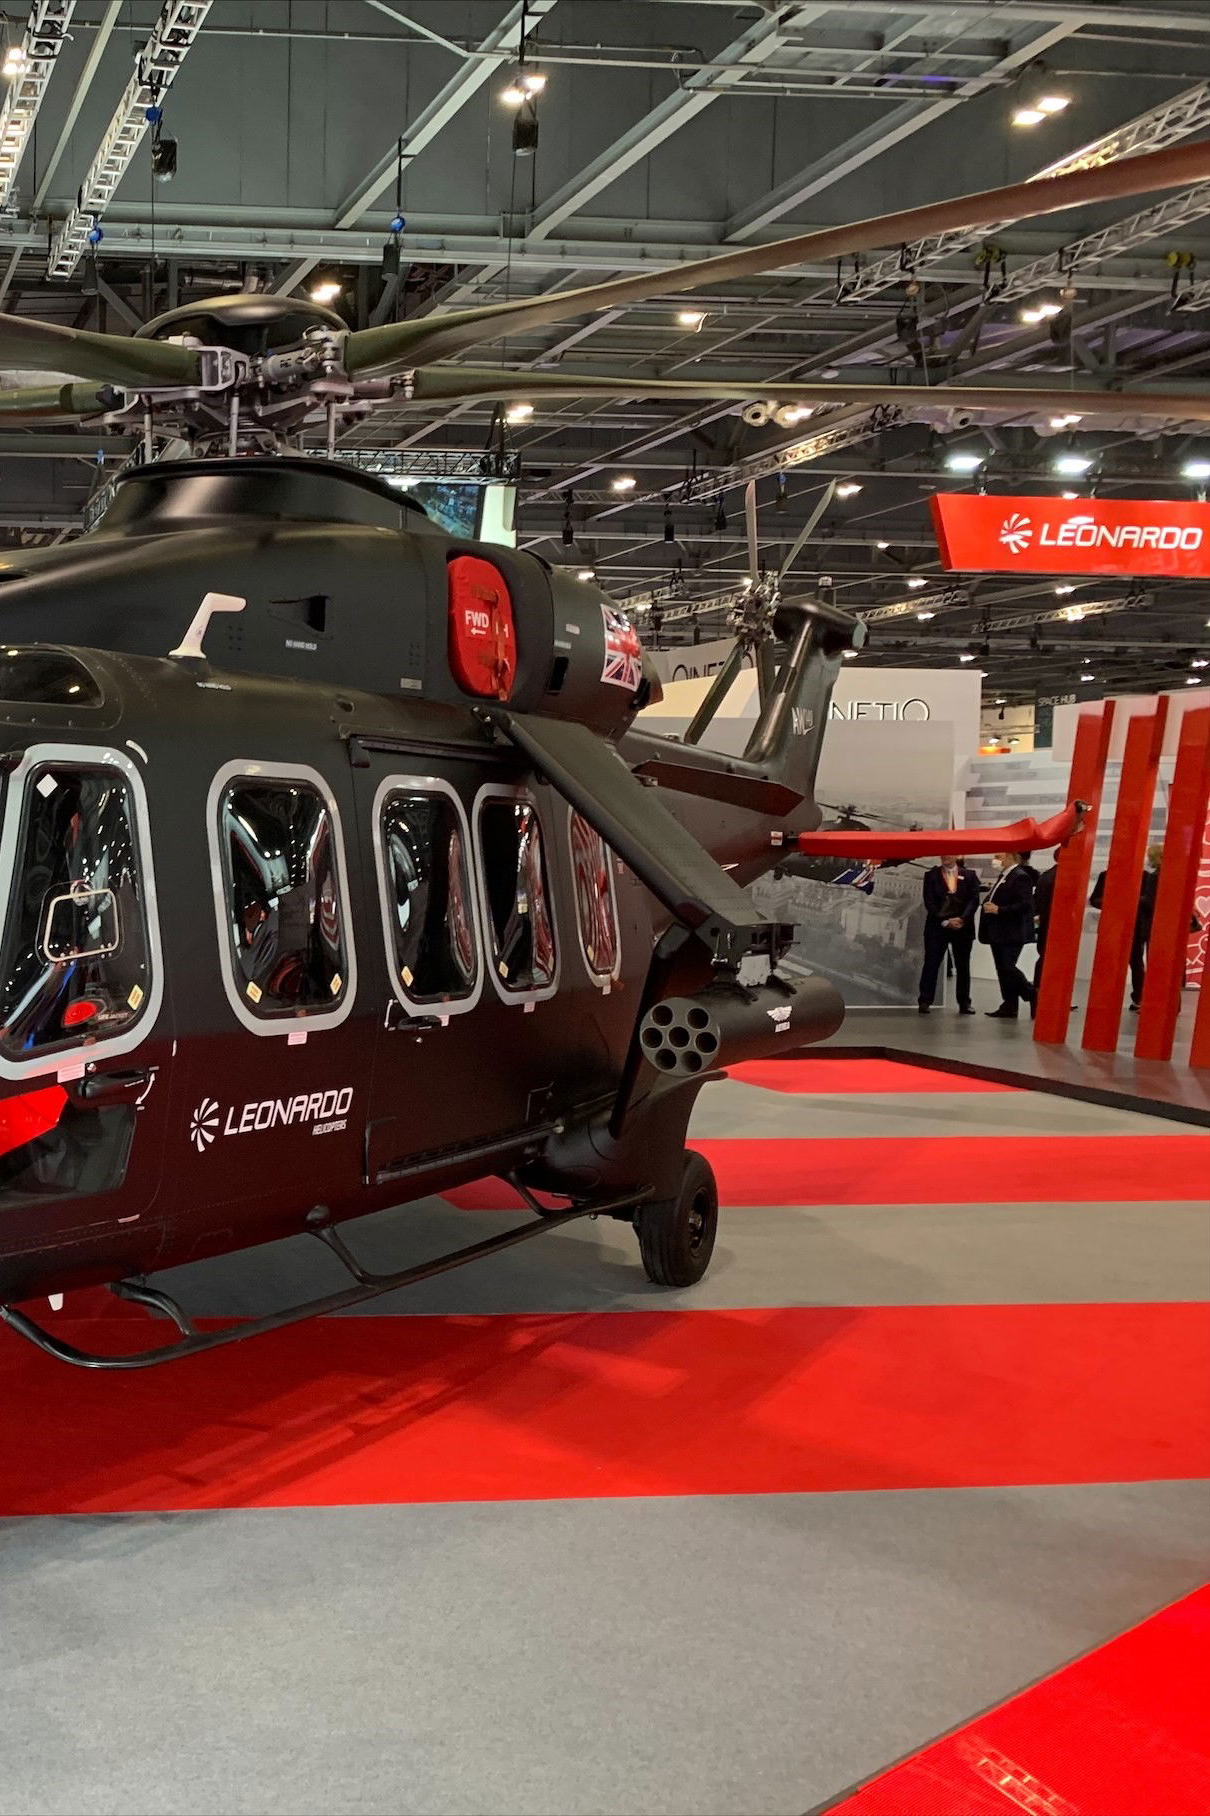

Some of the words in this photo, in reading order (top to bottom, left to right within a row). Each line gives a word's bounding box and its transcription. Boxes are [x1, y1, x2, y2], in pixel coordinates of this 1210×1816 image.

[1040, 523, 1203, 550] LEONARDO
[465, 610, 490, 628] FWD
[223, 1086, 354, 1136] LEONARDO
